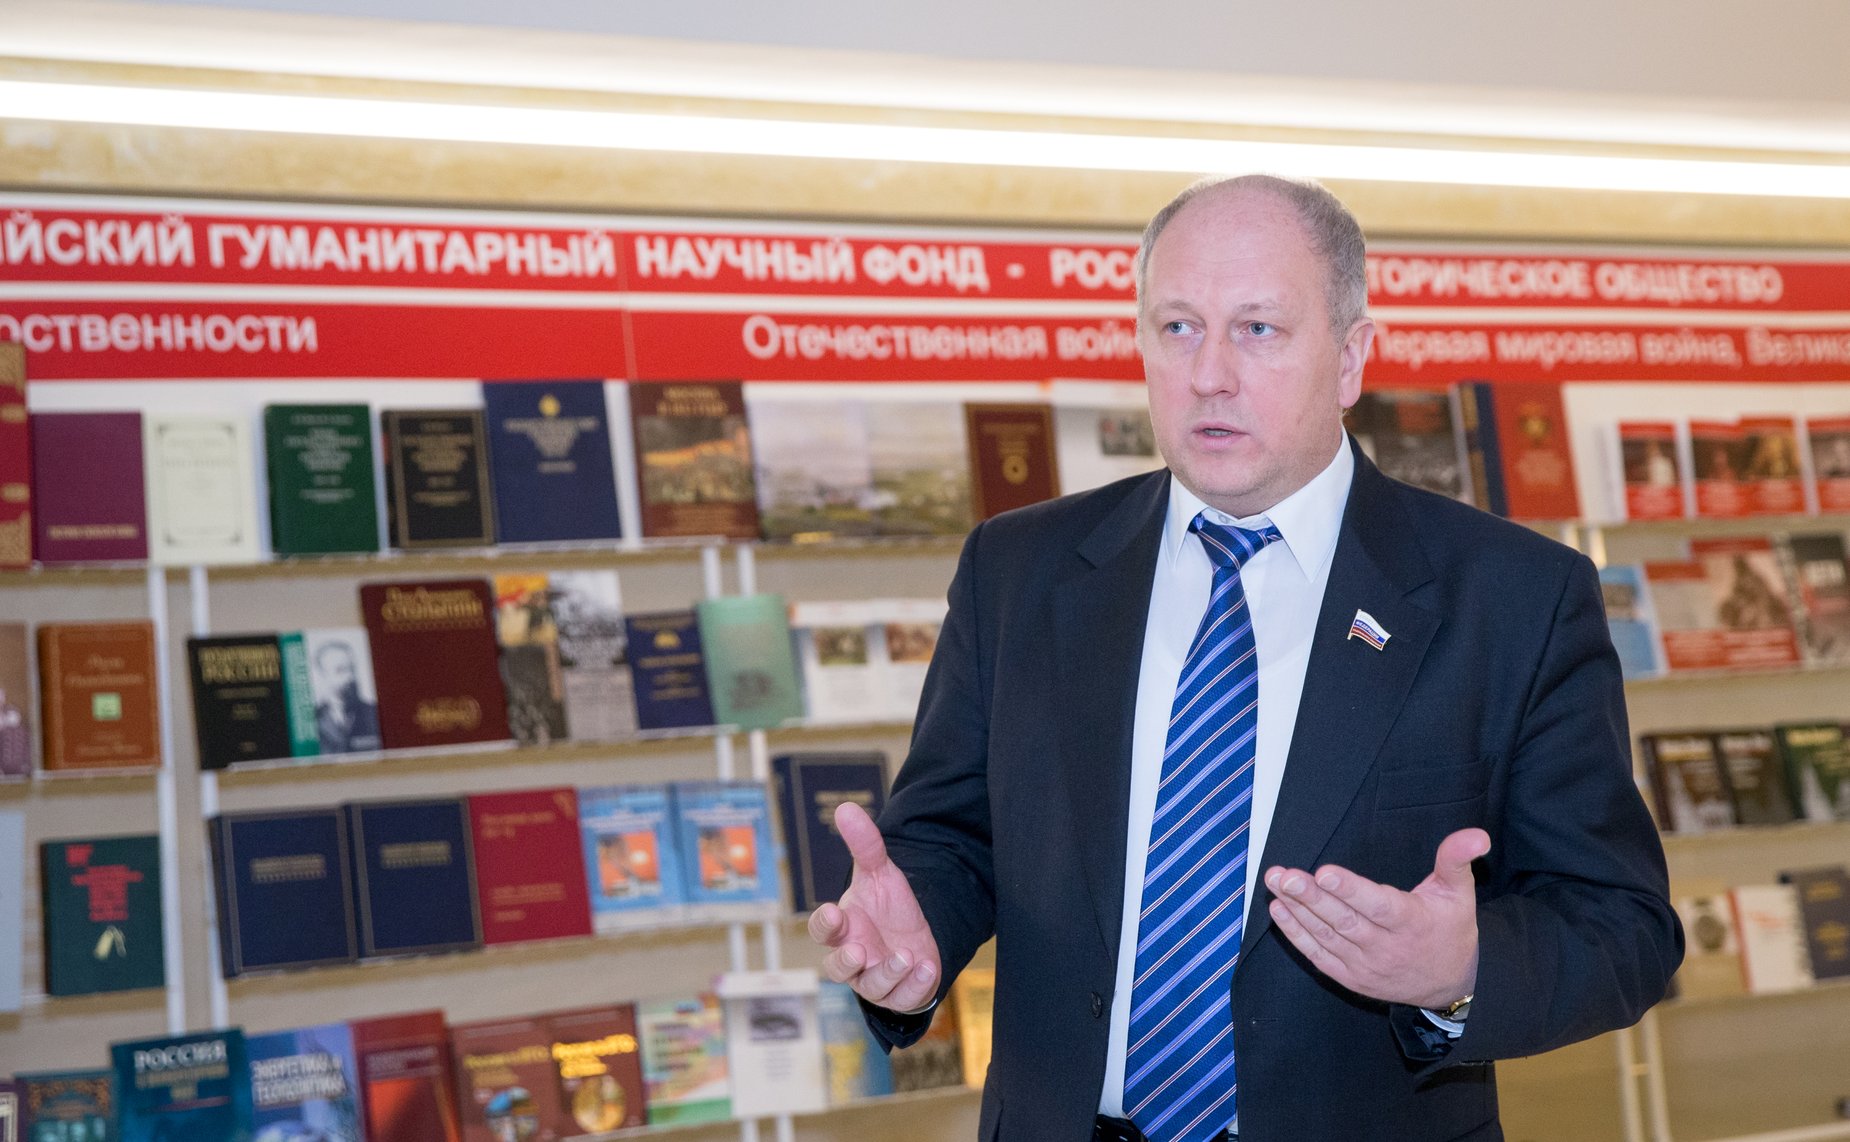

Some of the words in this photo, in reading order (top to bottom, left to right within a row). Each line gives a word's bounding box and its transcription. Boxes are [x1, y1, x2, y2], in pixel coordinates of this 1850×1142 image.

[0, 209, 195, 267] ЙСКИЙ
[207, 221, 615, 277] ГУМАНИТАРНЫЙ
[635, 235, 855, 284] НАУЧНЫЙ
[862, 245, 990, 294] ФОНД
[1049, 247, 1138, 291] РОС
[1596, 262, 1784, 306] ОБЩЕСТВО
[742, 314, 1048, 360] Отечественная
[1496, 329, 1635, 370] мировая
[1641, 325, 1743, 368] война,
